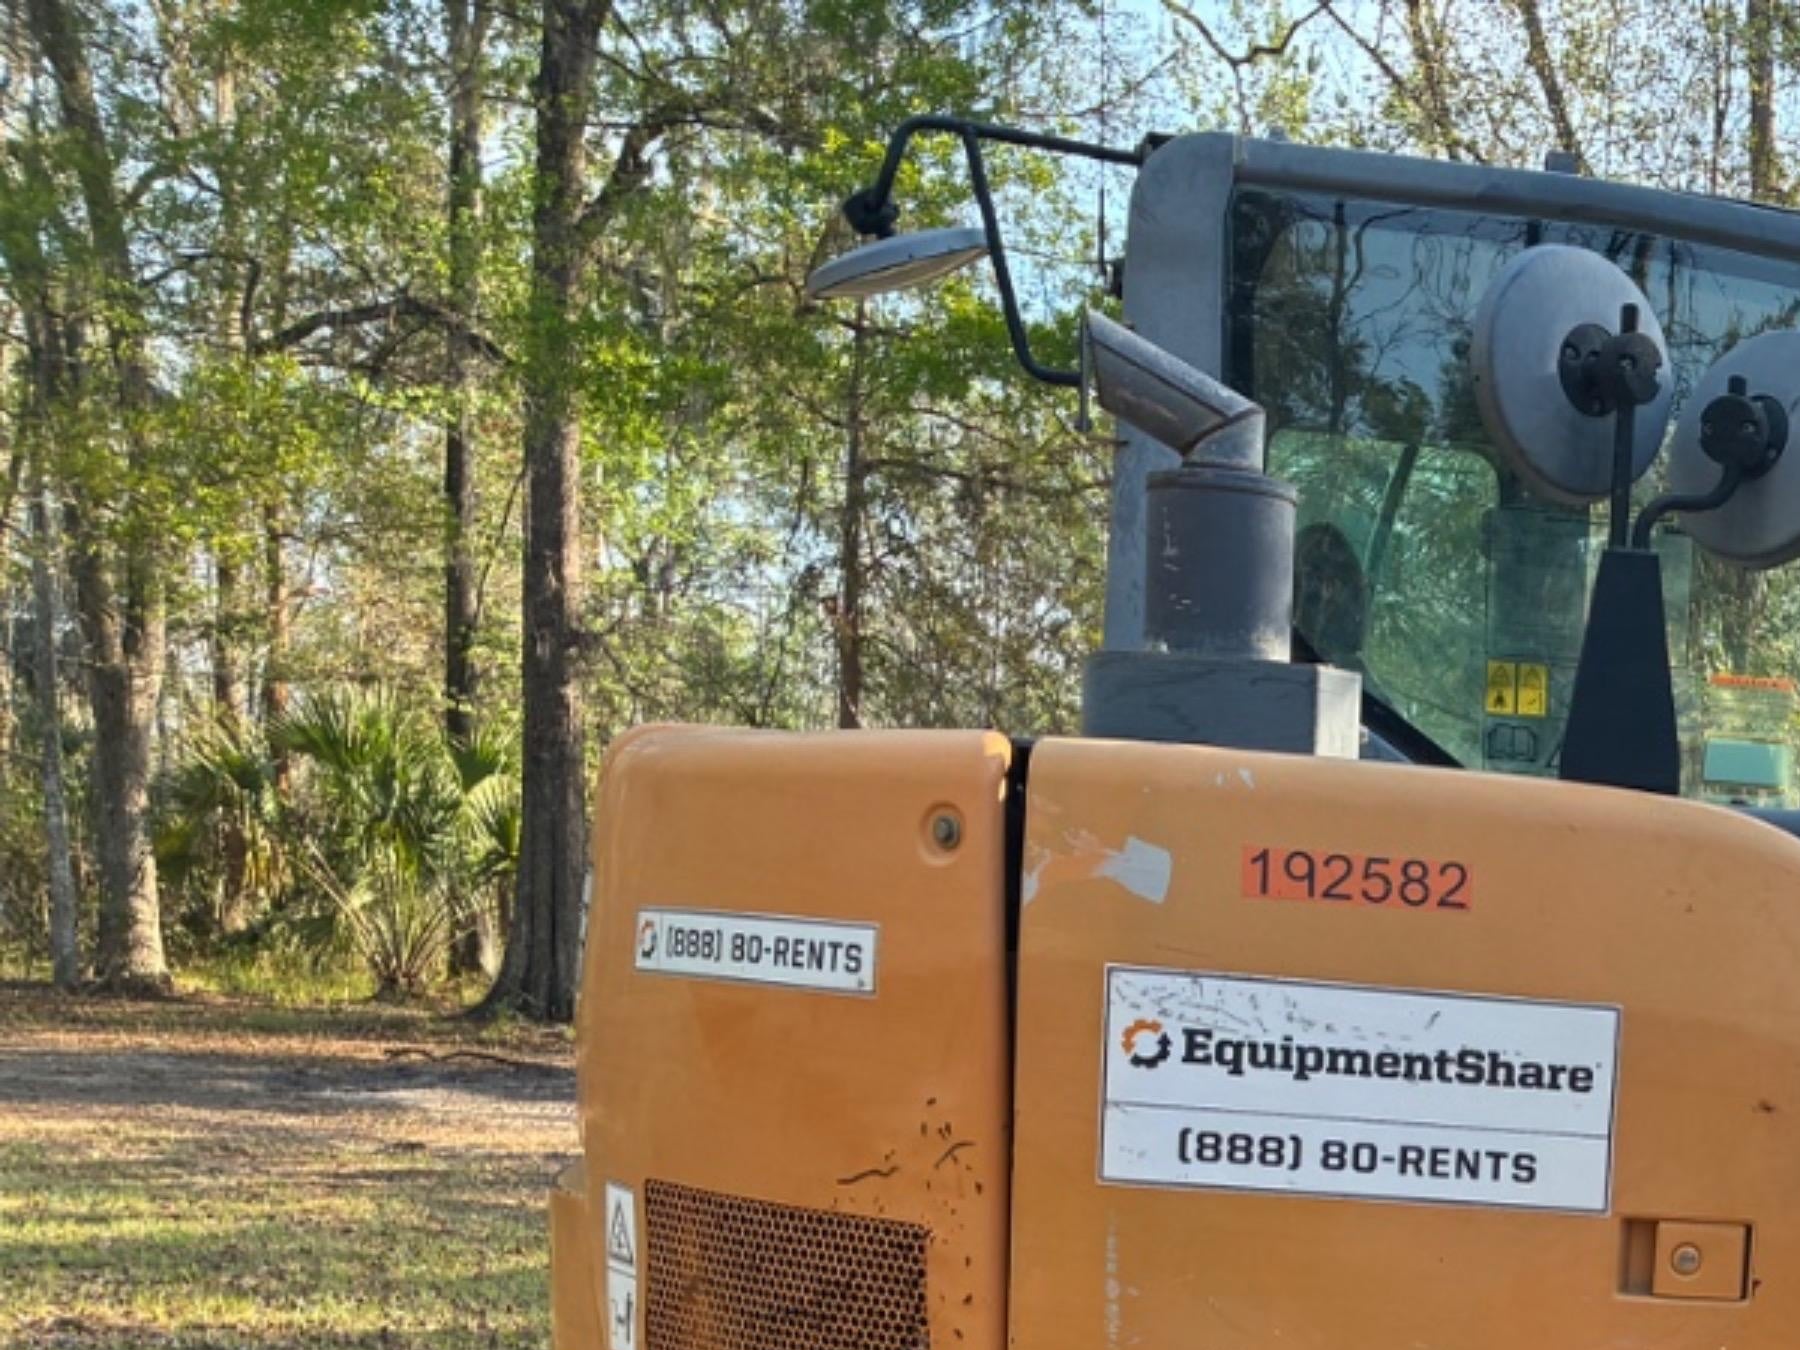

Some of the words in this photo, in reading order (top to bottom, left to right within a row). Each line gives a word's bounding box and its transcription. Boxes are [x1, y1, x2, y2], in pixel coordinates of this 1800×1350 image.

[1250, 848, 1469, 910] 192582
[667, 924, 723, 962] (888)
[730, 931, 863, 975] 80-RENTS
[1181, 1027, 1595, 1093] EquipmentShare
[1178, 1128, 1302, 1170] (888)
[1320, 1141, 1538, 1184] 80-RENTS
